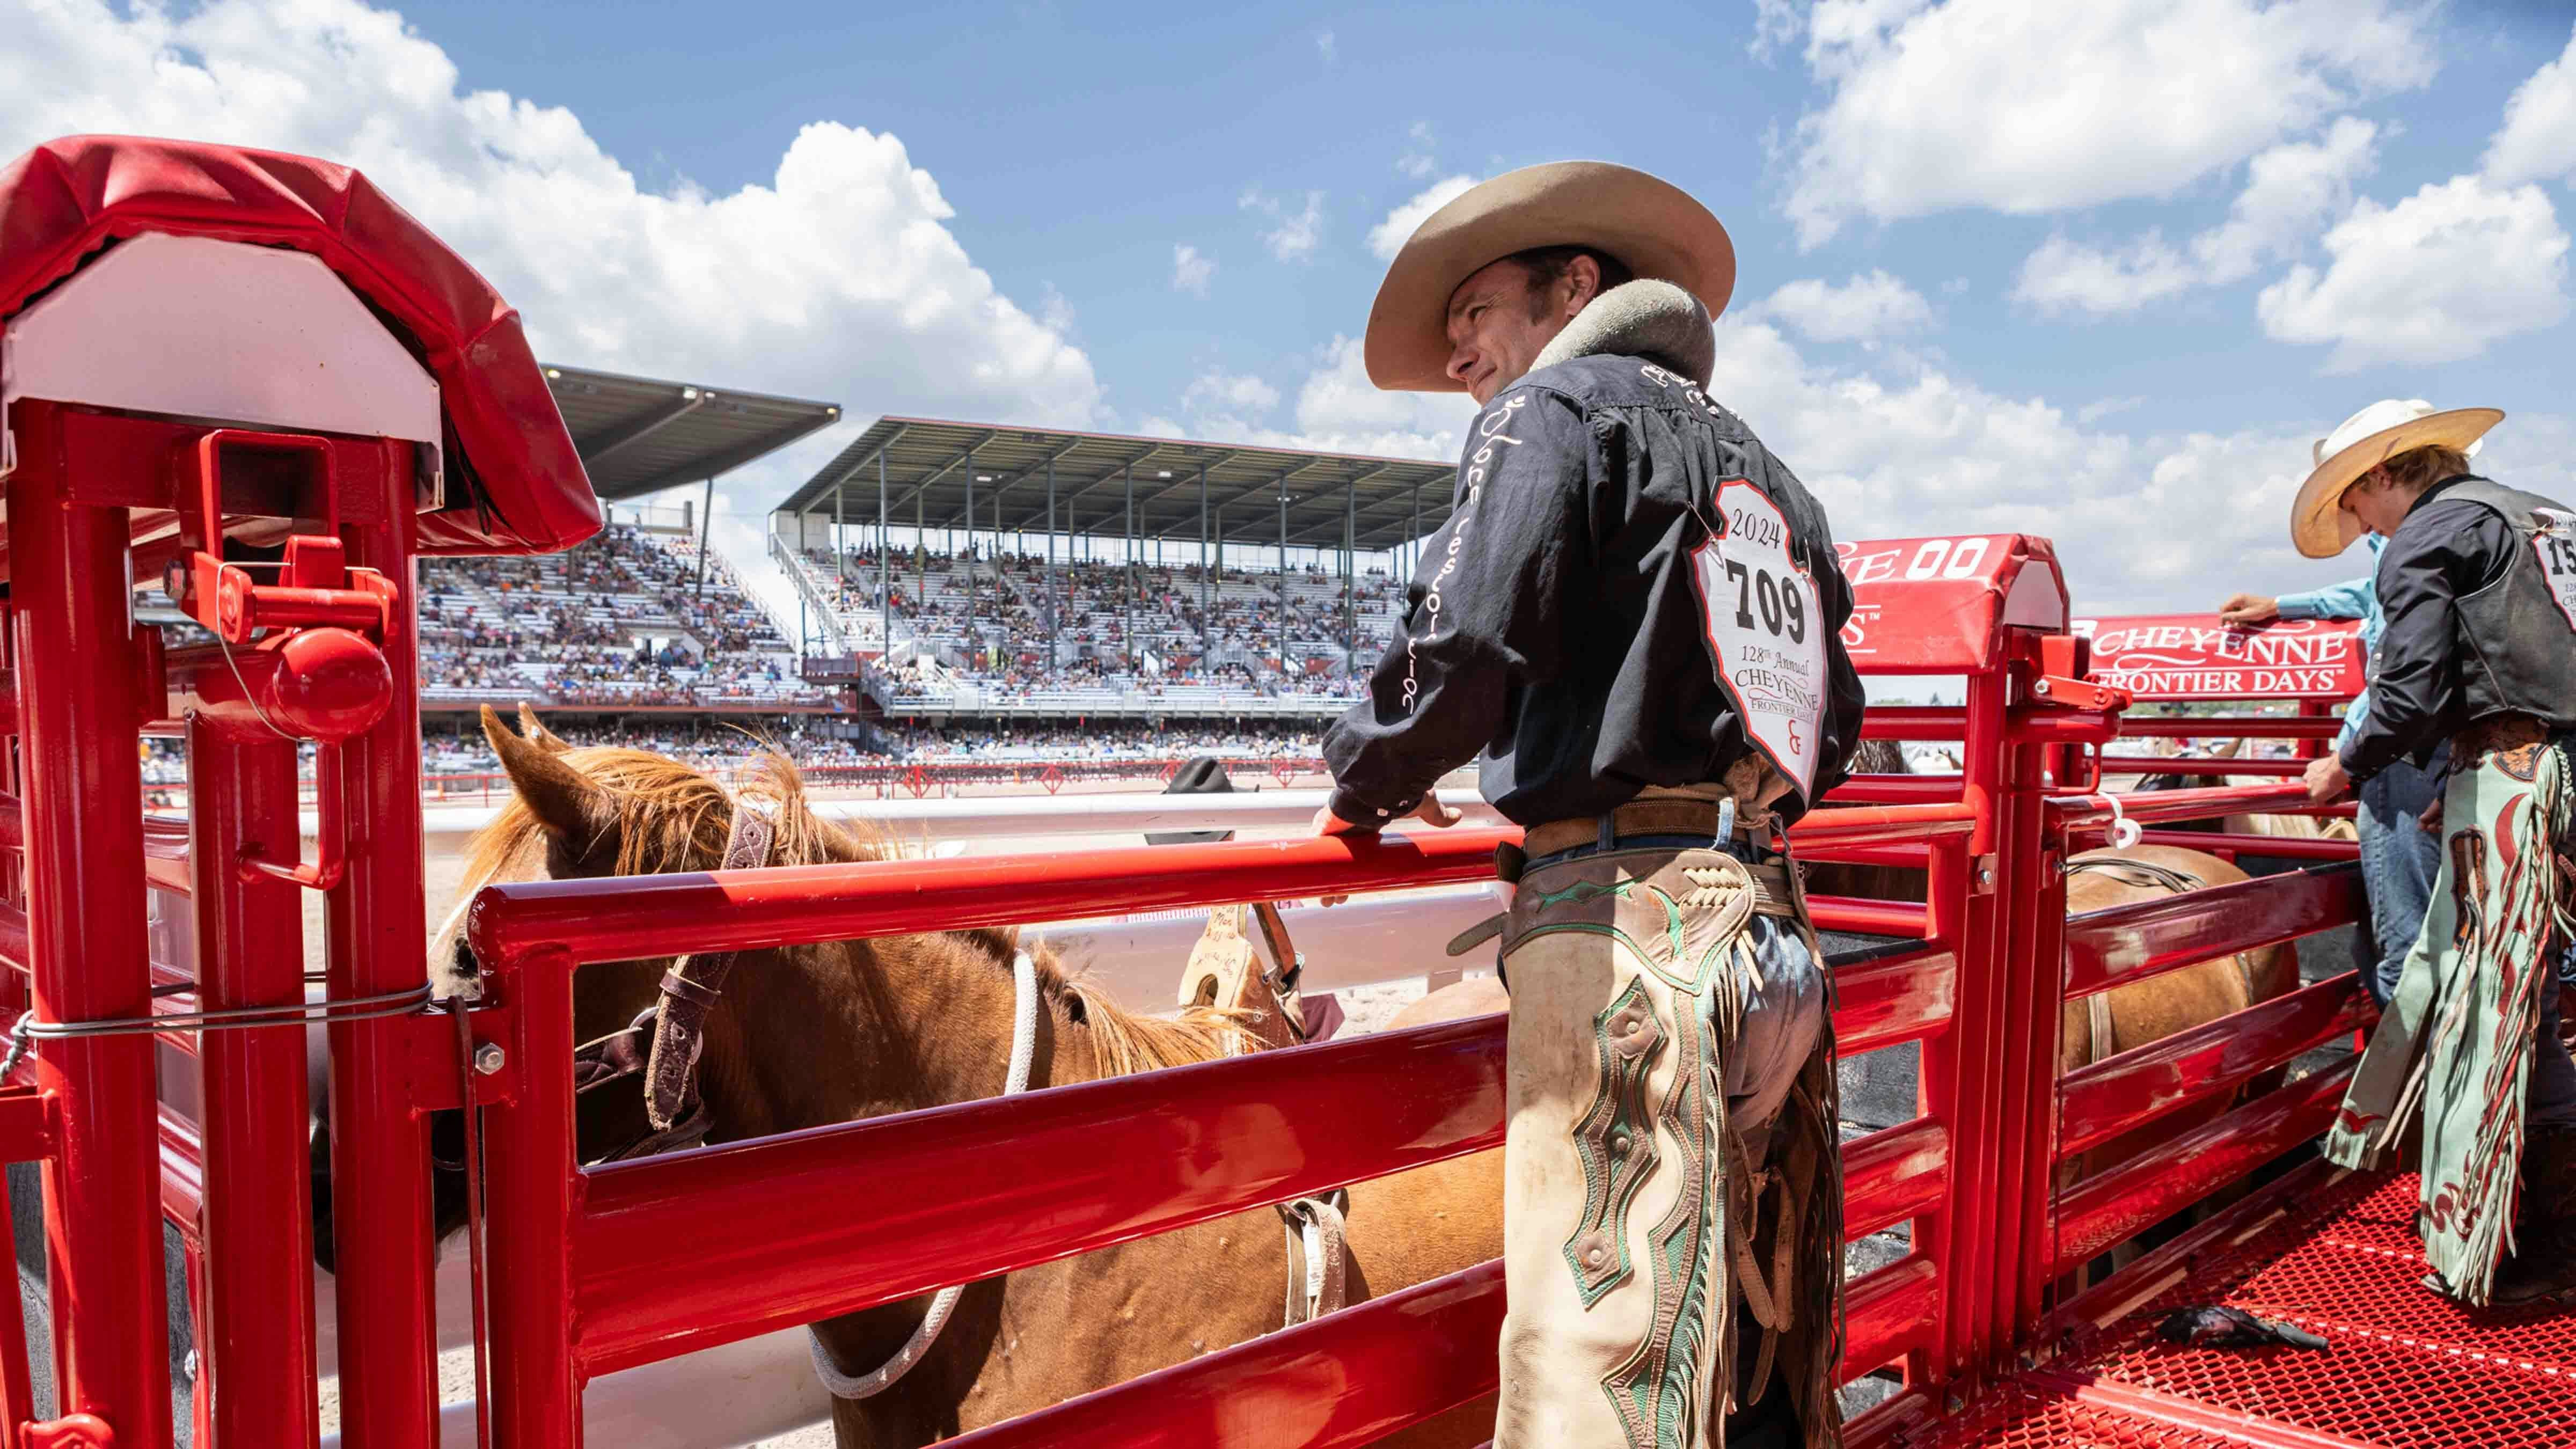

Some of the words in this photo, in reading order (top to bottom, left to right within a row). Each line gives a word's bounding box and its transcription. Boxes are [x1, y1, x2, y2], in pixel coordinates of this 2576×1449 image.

[1731, 508, 1781, 549] 2024
[1906, 538, 1990, 580] 00
[1725, 558, 1805, 645] 709
[1773, 652, 1810, 677] Annual
[2092, 626, 2348, 665] CHEYENNE
[1735, 668, 1818, 711] CHEYENNE
[2098, 671, 2243, 693] FRONTIER
[1751, 699, 1795, 714] FRONTIER
